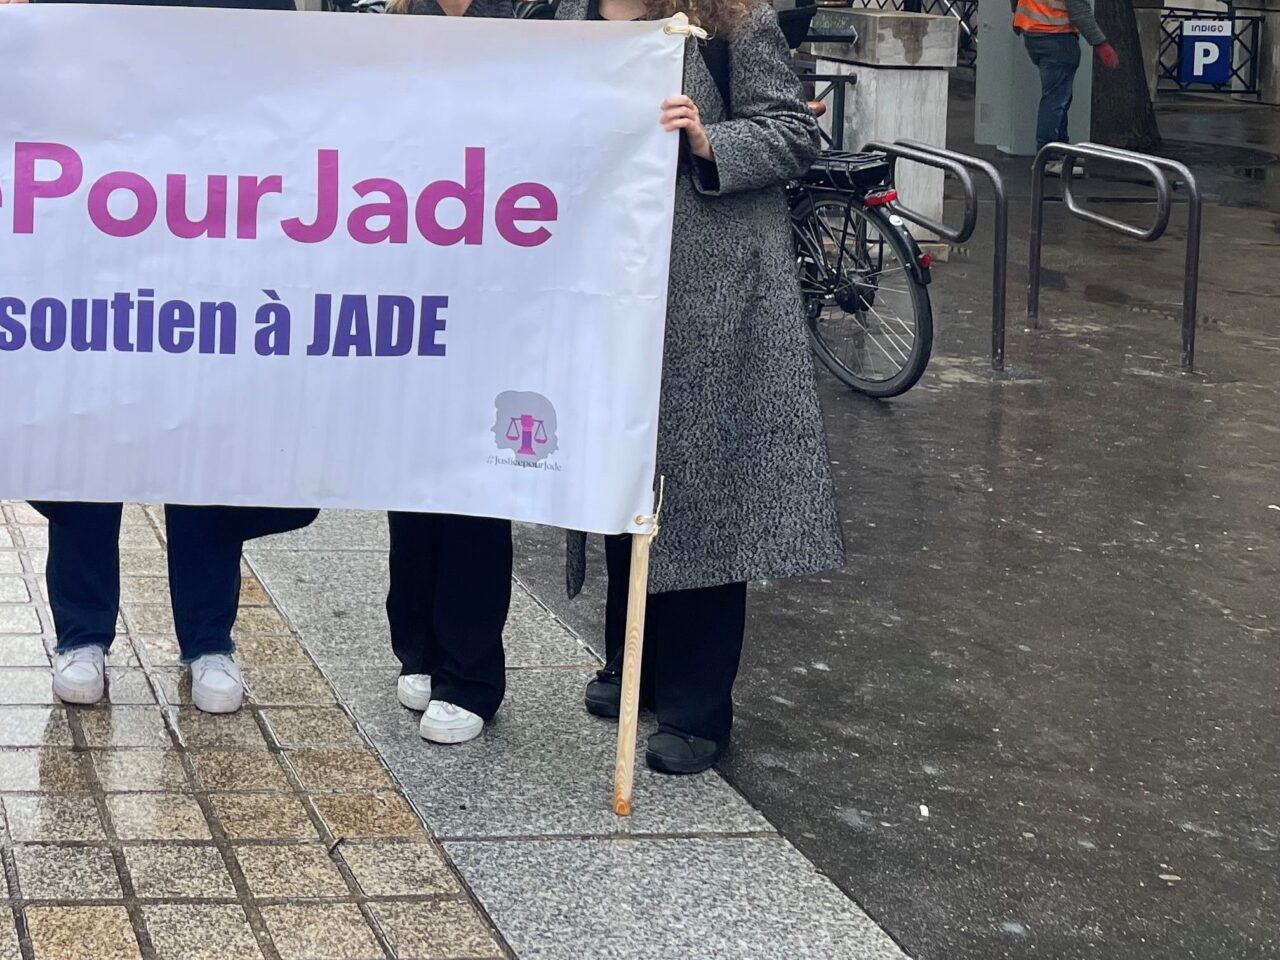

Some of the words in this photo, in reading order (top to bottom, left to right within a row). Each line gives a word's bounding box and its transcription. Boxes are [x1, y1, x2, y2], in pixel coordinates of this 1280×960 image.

[1191, 24, 1224, 33] INDIGO
[1193, 41, 1220, 76] P
[254, 290, 291, 356] à
[307, 294, 449, 357] JADE
